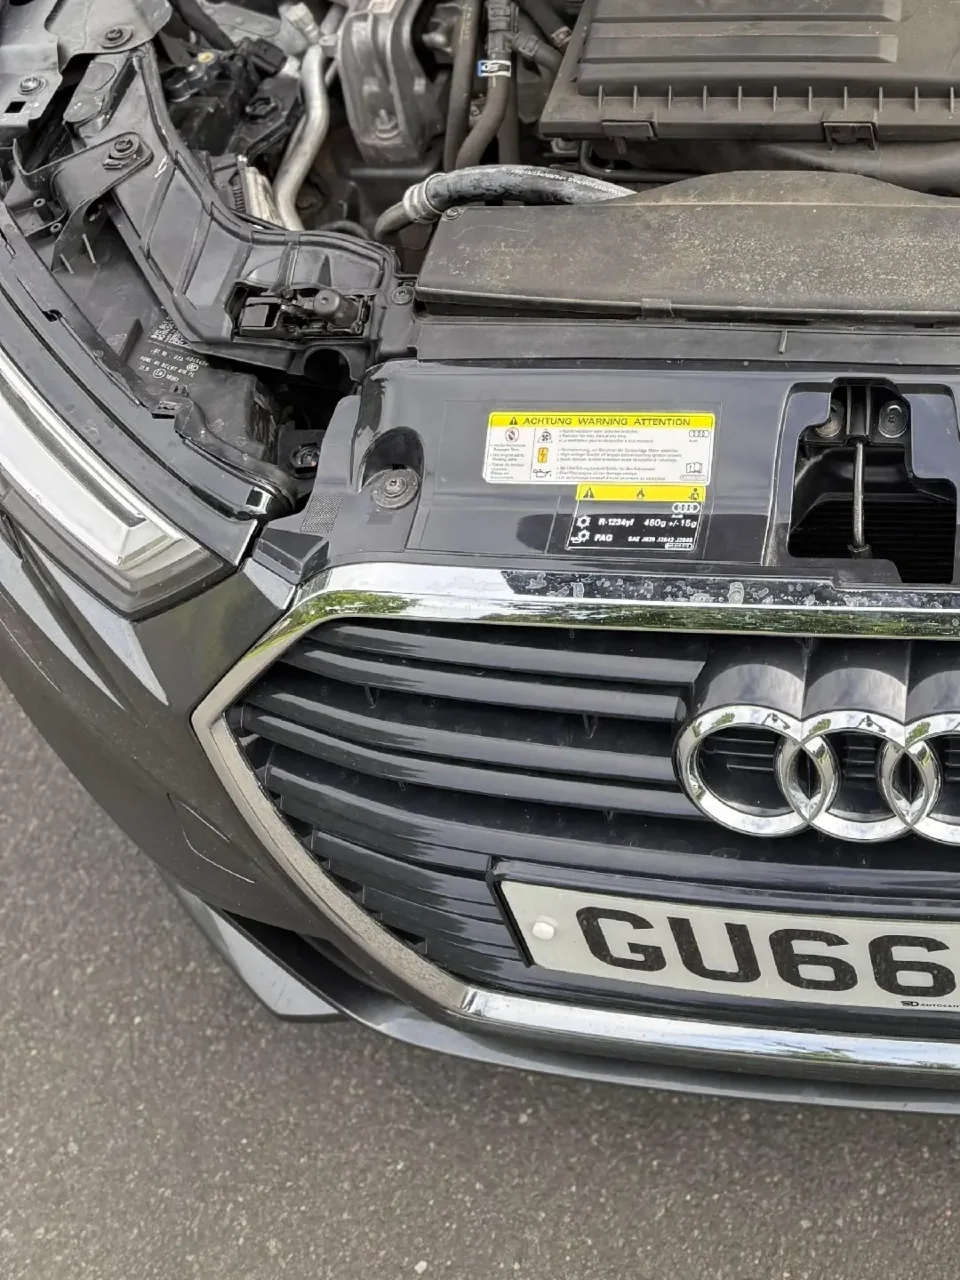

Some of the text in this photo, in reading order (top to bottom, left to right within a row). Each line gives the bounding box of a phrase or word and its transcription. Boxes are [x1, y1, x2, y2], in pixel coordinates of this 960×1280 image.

[523, 417, 691, 426] ACHTUNG WARNING ATTENTION
[598, 518, 635, 527] R-1234yf
[594, 534, 614, 542] PAG
[575, 906, 957, 998] GU66
